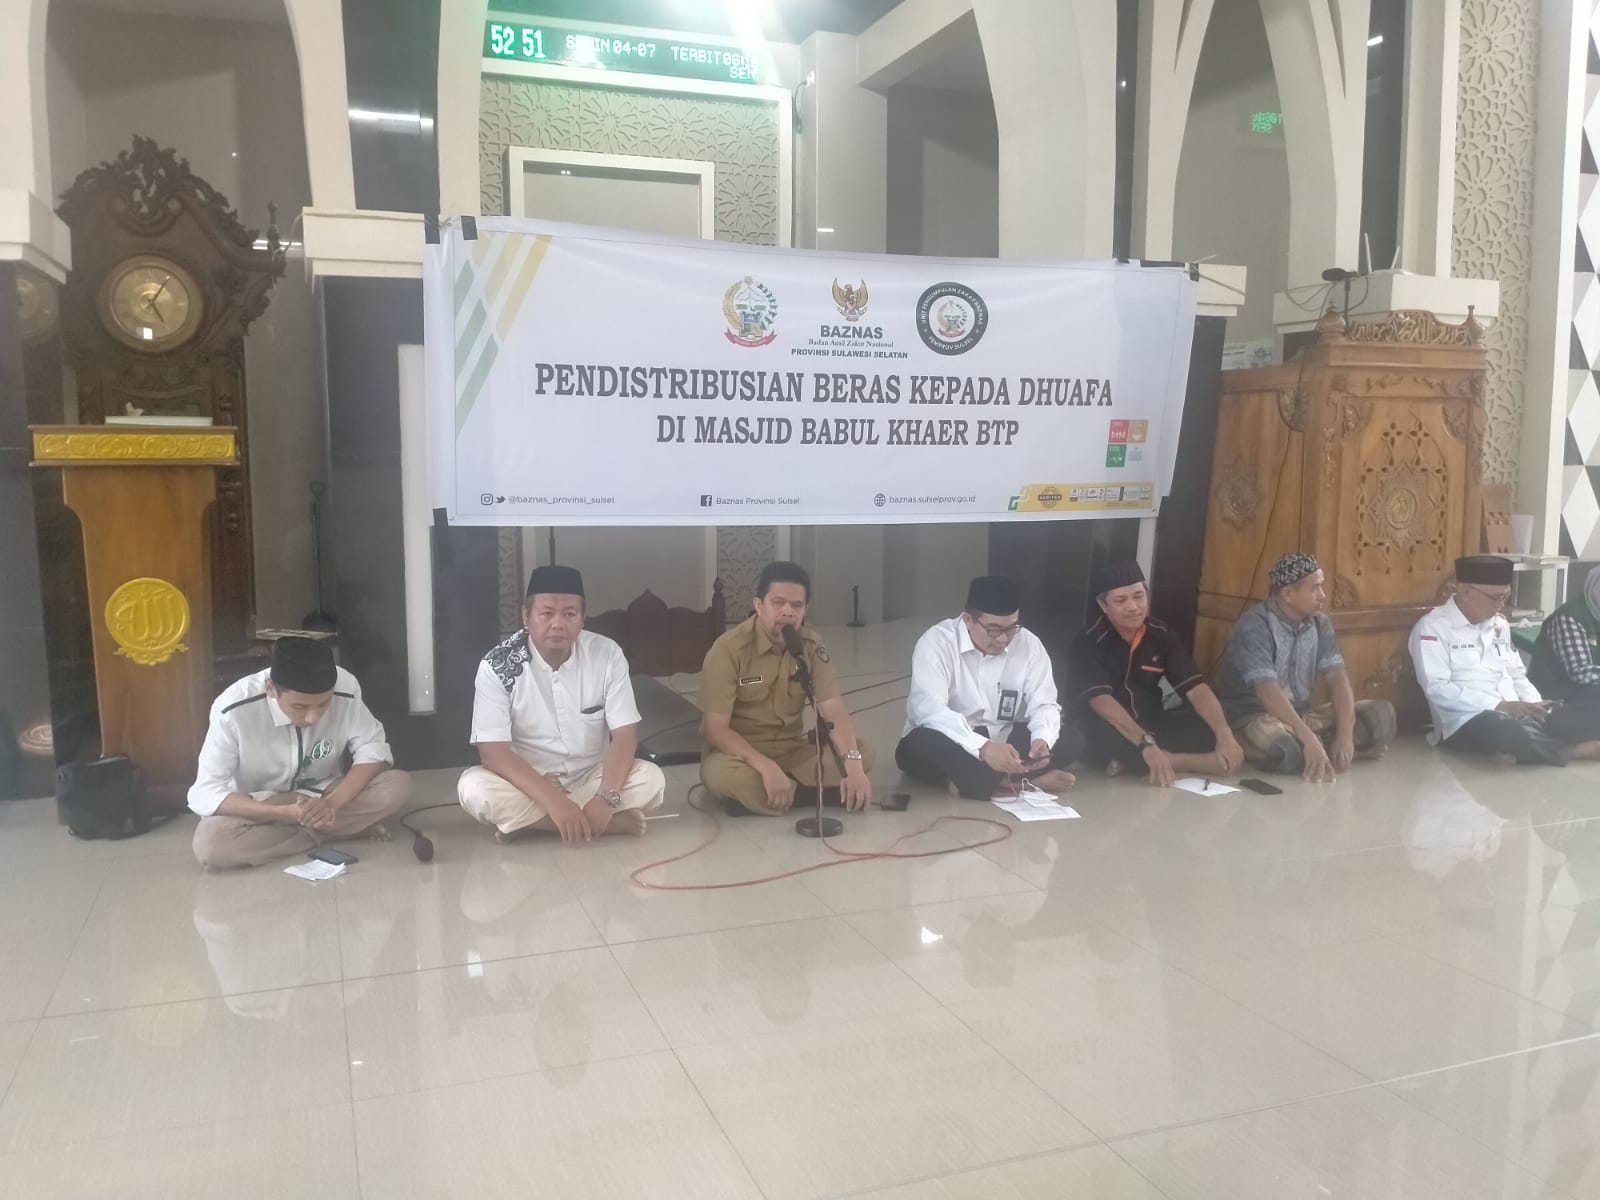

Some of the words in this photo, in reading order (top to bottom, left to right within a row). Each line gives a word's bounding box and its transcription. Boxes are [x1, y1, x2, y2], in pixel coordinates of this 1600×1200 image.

[490, 24, 515, 55] 52
[521, 28, 546, 58] 51
[565, 34, 610, 53] SIN
[612, 39, 657, 57] 04-07
[670, 46, 721, 65] TERBIT
[820, 325, 883, 339] BAZNAS
[808, 338, 829, 346] Badan
[829, 339, 846, 347] Amil
[846, 340, 865, 348] Zakat
[791, 348, 830, 357] PROVINSI
[831, 349, 872, 358] SULAWESI
[873, 351, 909, 359] SELATAN
[535, 363, 804, 402] PENDISTRIBUSIAN
[813, 373, 901, 404] BERAS
[909, 375, 1011, 405] KEPADA
[1018, 377, 1113, 406] DHUAFA
[657, 415, 686, 443] DI
[694, 416, 792, 444] MASJID
[800, 418, 880, 445] BABUL
[886, 419, 969, 445] KHAER
[975, 419, 1020, 446] BTP
[508, 495, 615, 505] @baznas_provinsi_sulsel
[716, 496, 744, 505] Baznas
[745, 496, 776, 505] Provinsi
[777, 496, 800, 505] Sulsel
[889, 495, 976, 504] baznas.sulselprov.go.id
